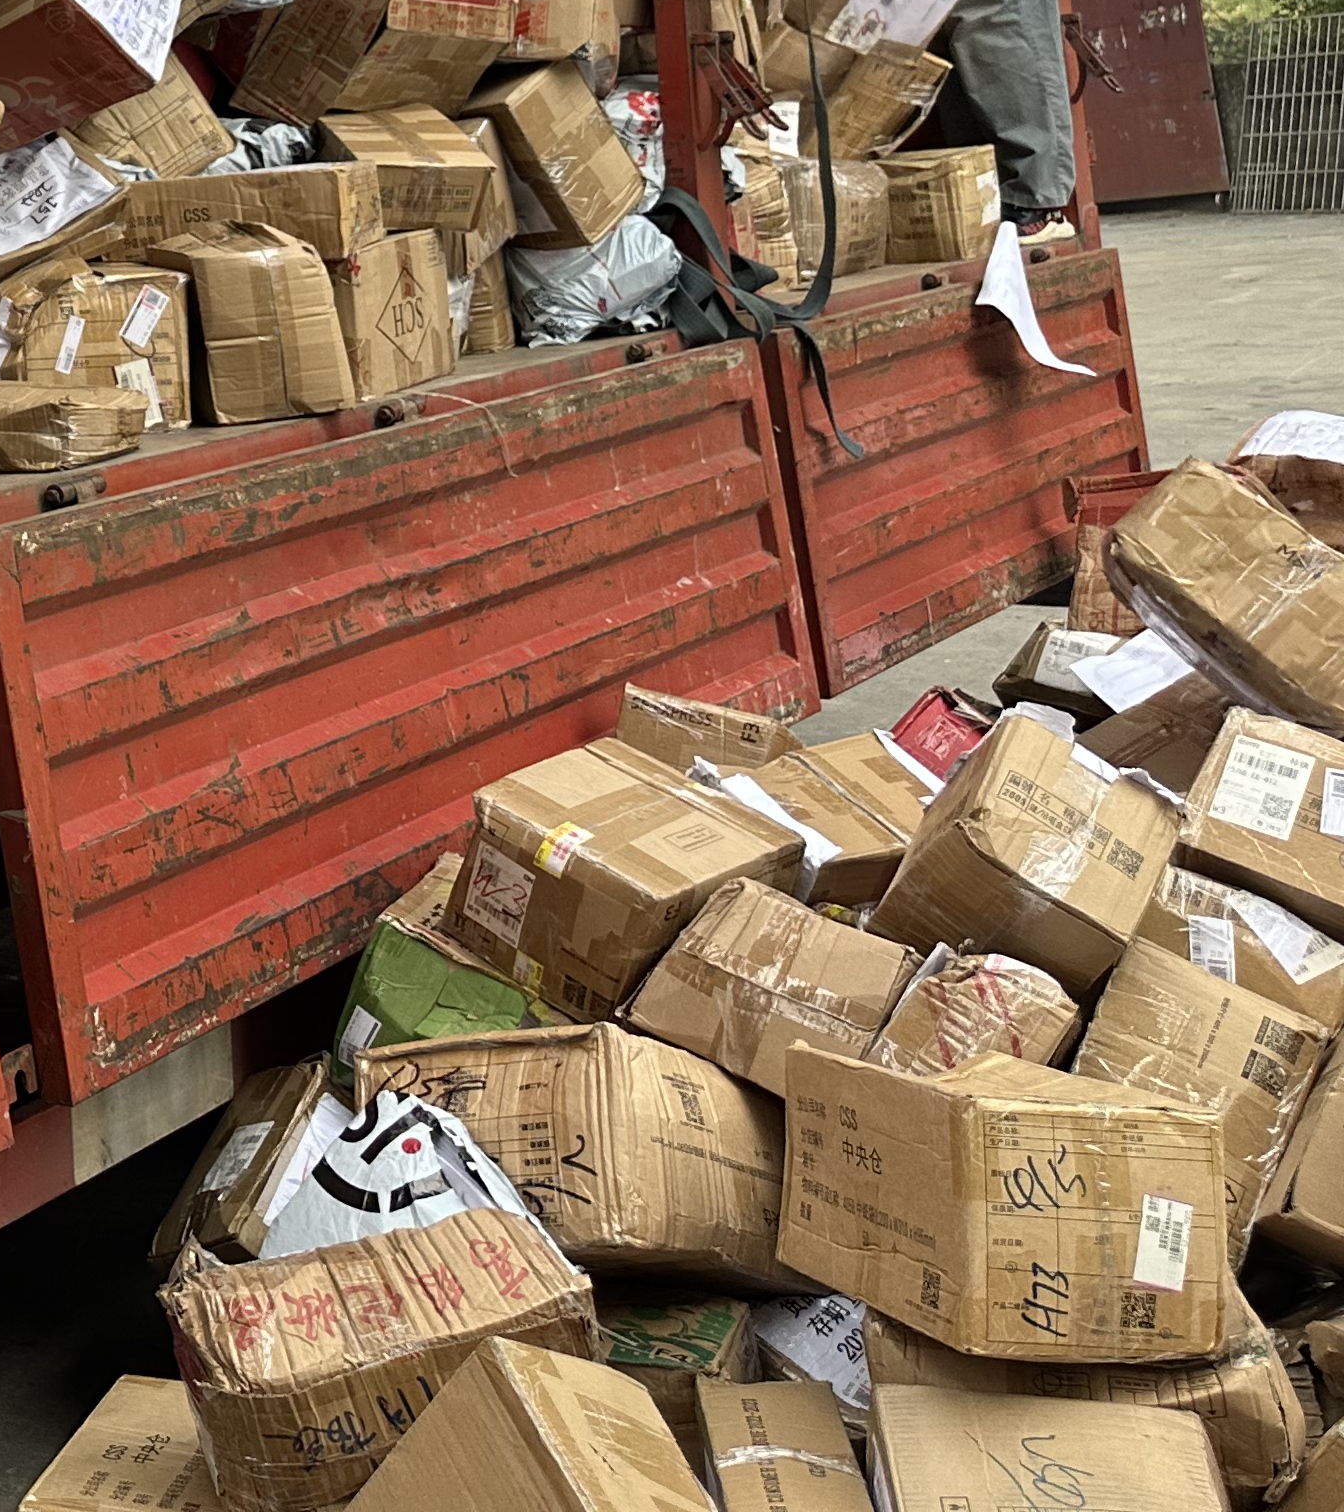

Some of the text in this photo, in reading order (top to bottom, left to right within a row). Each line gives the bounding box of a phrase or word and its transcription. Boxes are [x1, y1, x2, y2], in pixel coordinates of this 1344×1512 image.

[183, 206, 211, 225] CSS
[739, 722, 762, 744] F3
[663, 902, 685, 923] F3
[838, 1104, 859, 1132] CSS
[841, 1136, 884, 1177] 中央仓
[806, 1297, 852, 1338] 存期
[654, 1345, 688, 1364] F4
[100, 1443, 128, 1463] CSS
[131, 1433, 171, 1466] 中央仓
